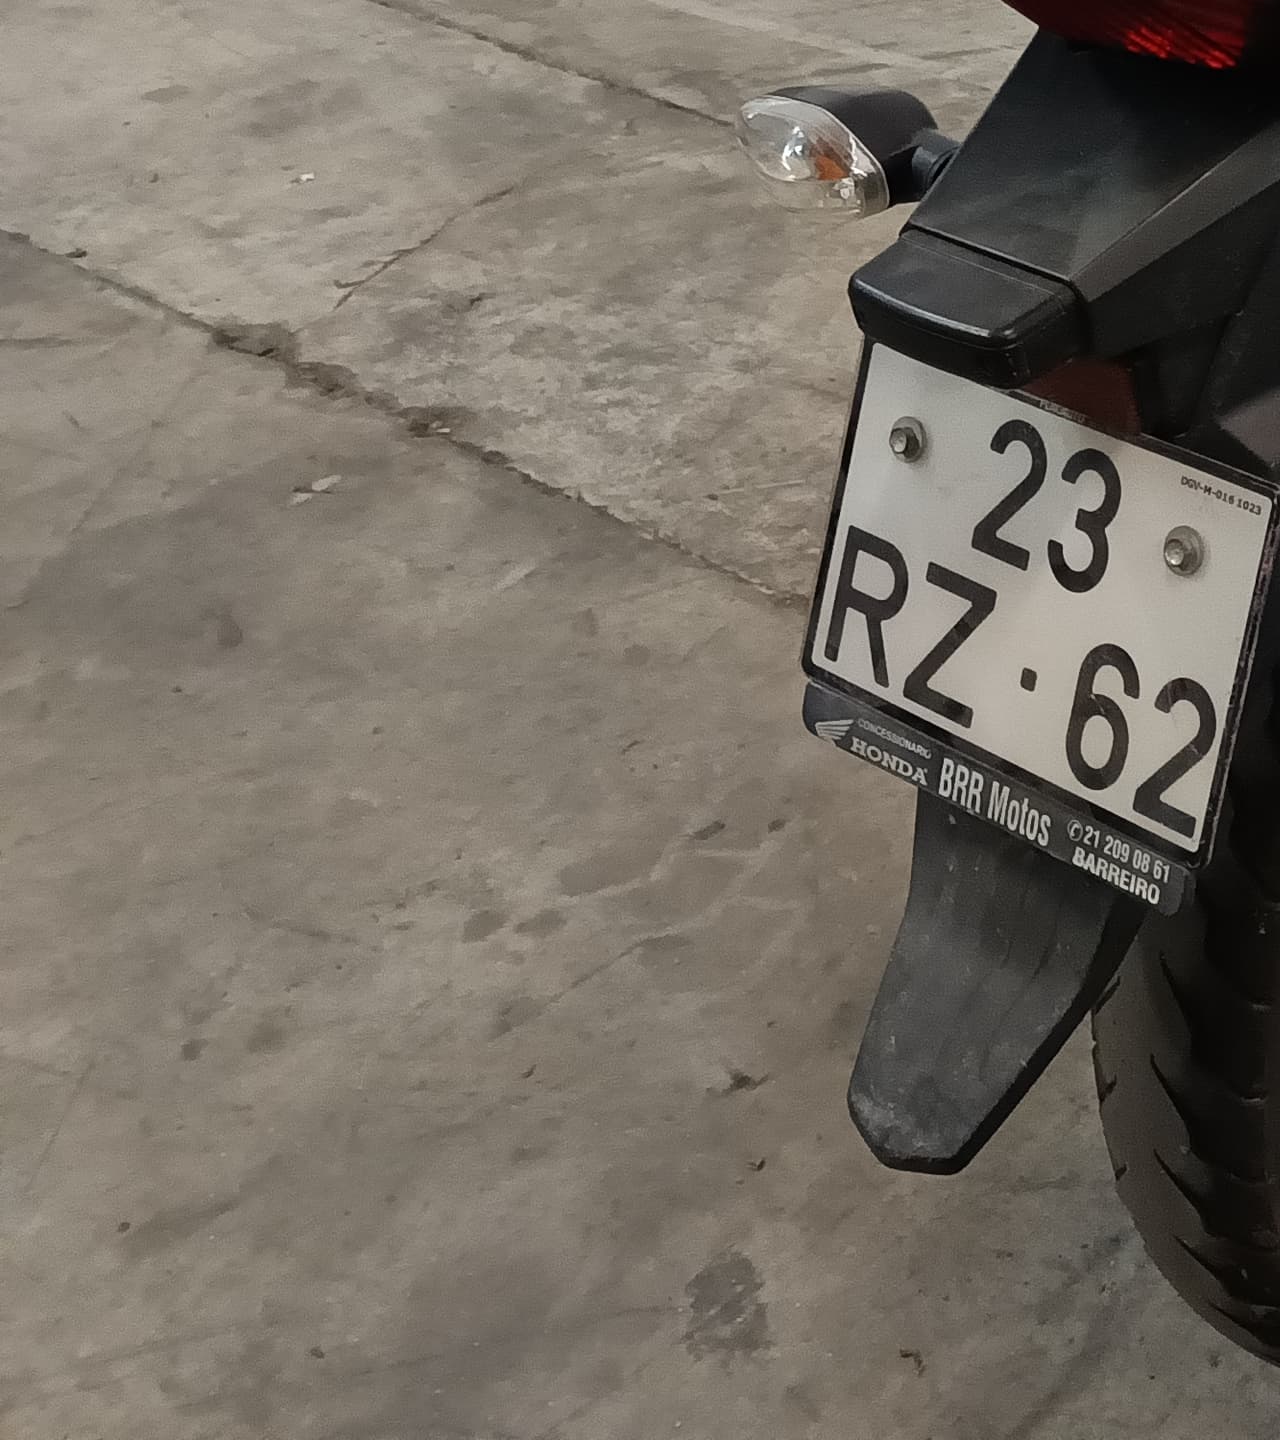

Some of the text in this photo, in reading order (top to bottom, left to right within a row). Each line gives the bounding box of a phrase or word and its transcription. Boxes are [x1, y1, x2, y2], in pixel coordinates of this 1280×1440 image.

[972, 419, 1122, 593] 23
[851, 736, 928, 786] HONDA
[938, 757, 1051, 846] BRR Motos
[1071, 846, 1161, 905] BARREIRO
[1083, 825, 1170, 884] 21 209 08 61
